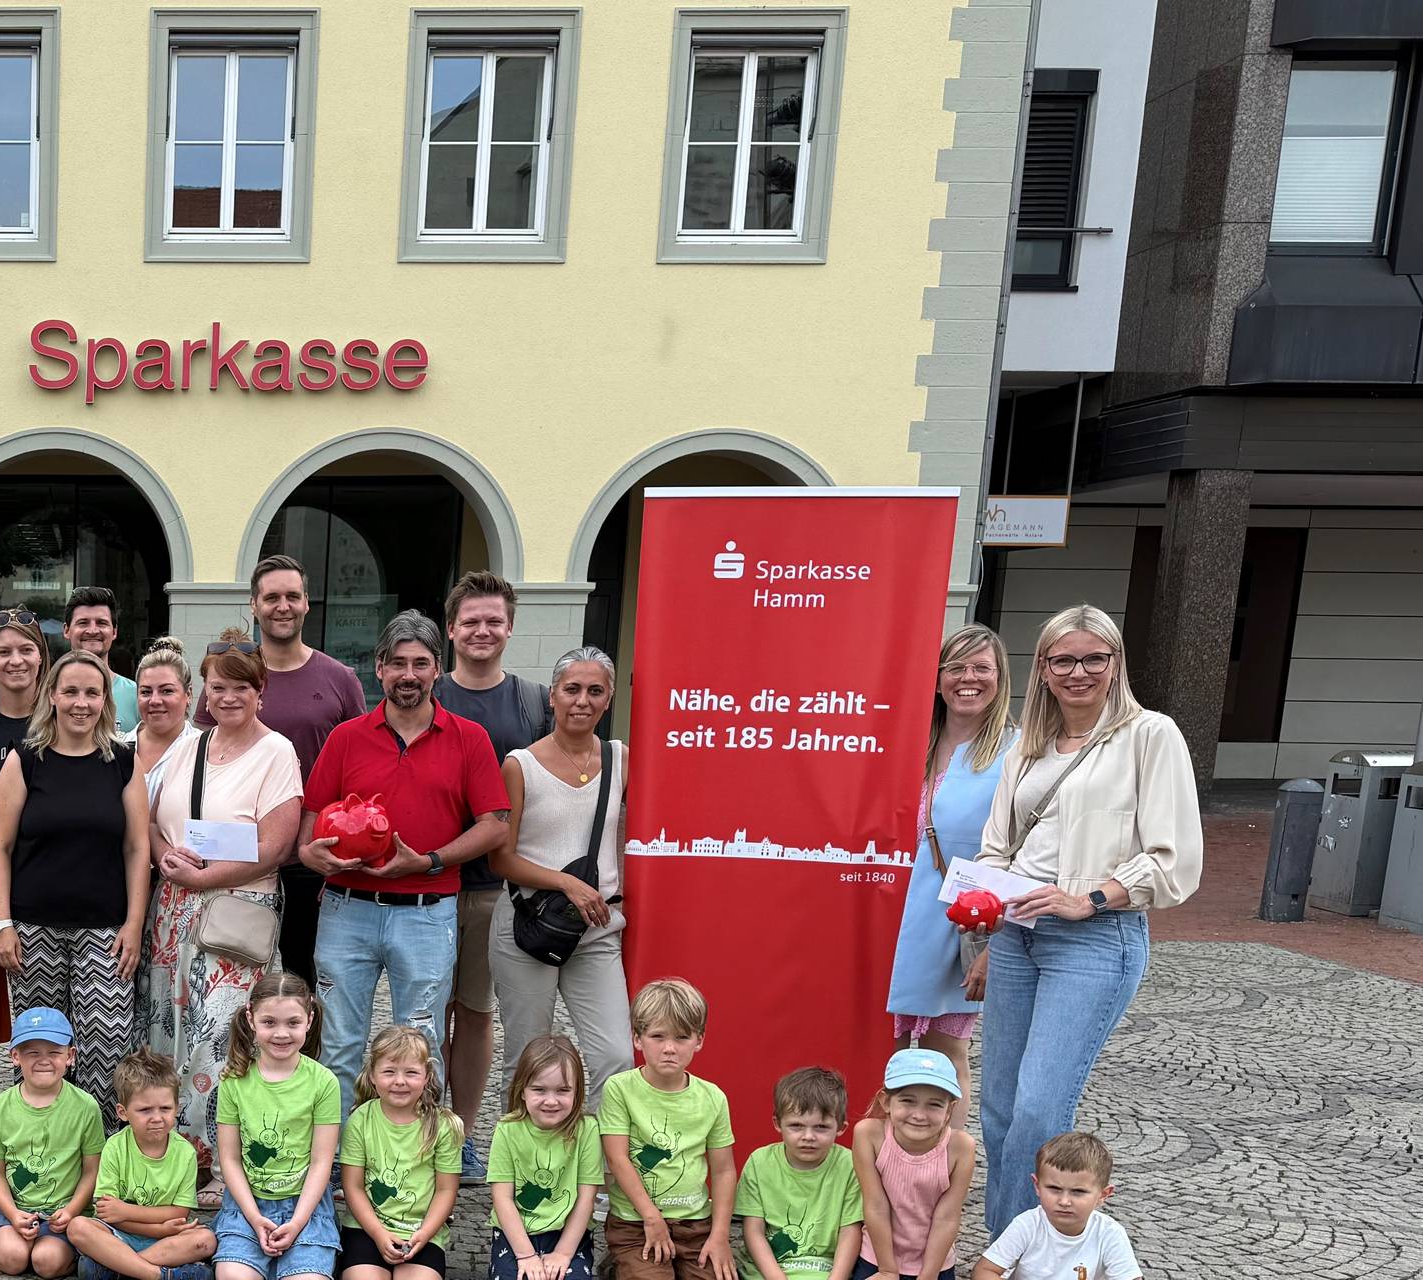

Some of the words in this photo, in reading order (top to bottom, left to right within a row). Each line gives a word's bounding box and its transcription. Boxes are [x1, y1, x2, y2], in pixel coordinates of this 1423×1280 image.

[29, 319, 429, 404] Sparkasse
[755, 560, 871, 584] Sparkasse
[753, 589, 825, 608] Hamm
[669, 688, 741, 715] Nähe,
[750, 689, 791, 712] die
[798, 691, 866, 715] zählt
[666, 725, 716, 748] seit
[724, 727, 773, 749] 185
[782, 728, 884, 752] Jahren.
[840, 871, 862, 882] seit
[865, 872, 895, 883] 1840
